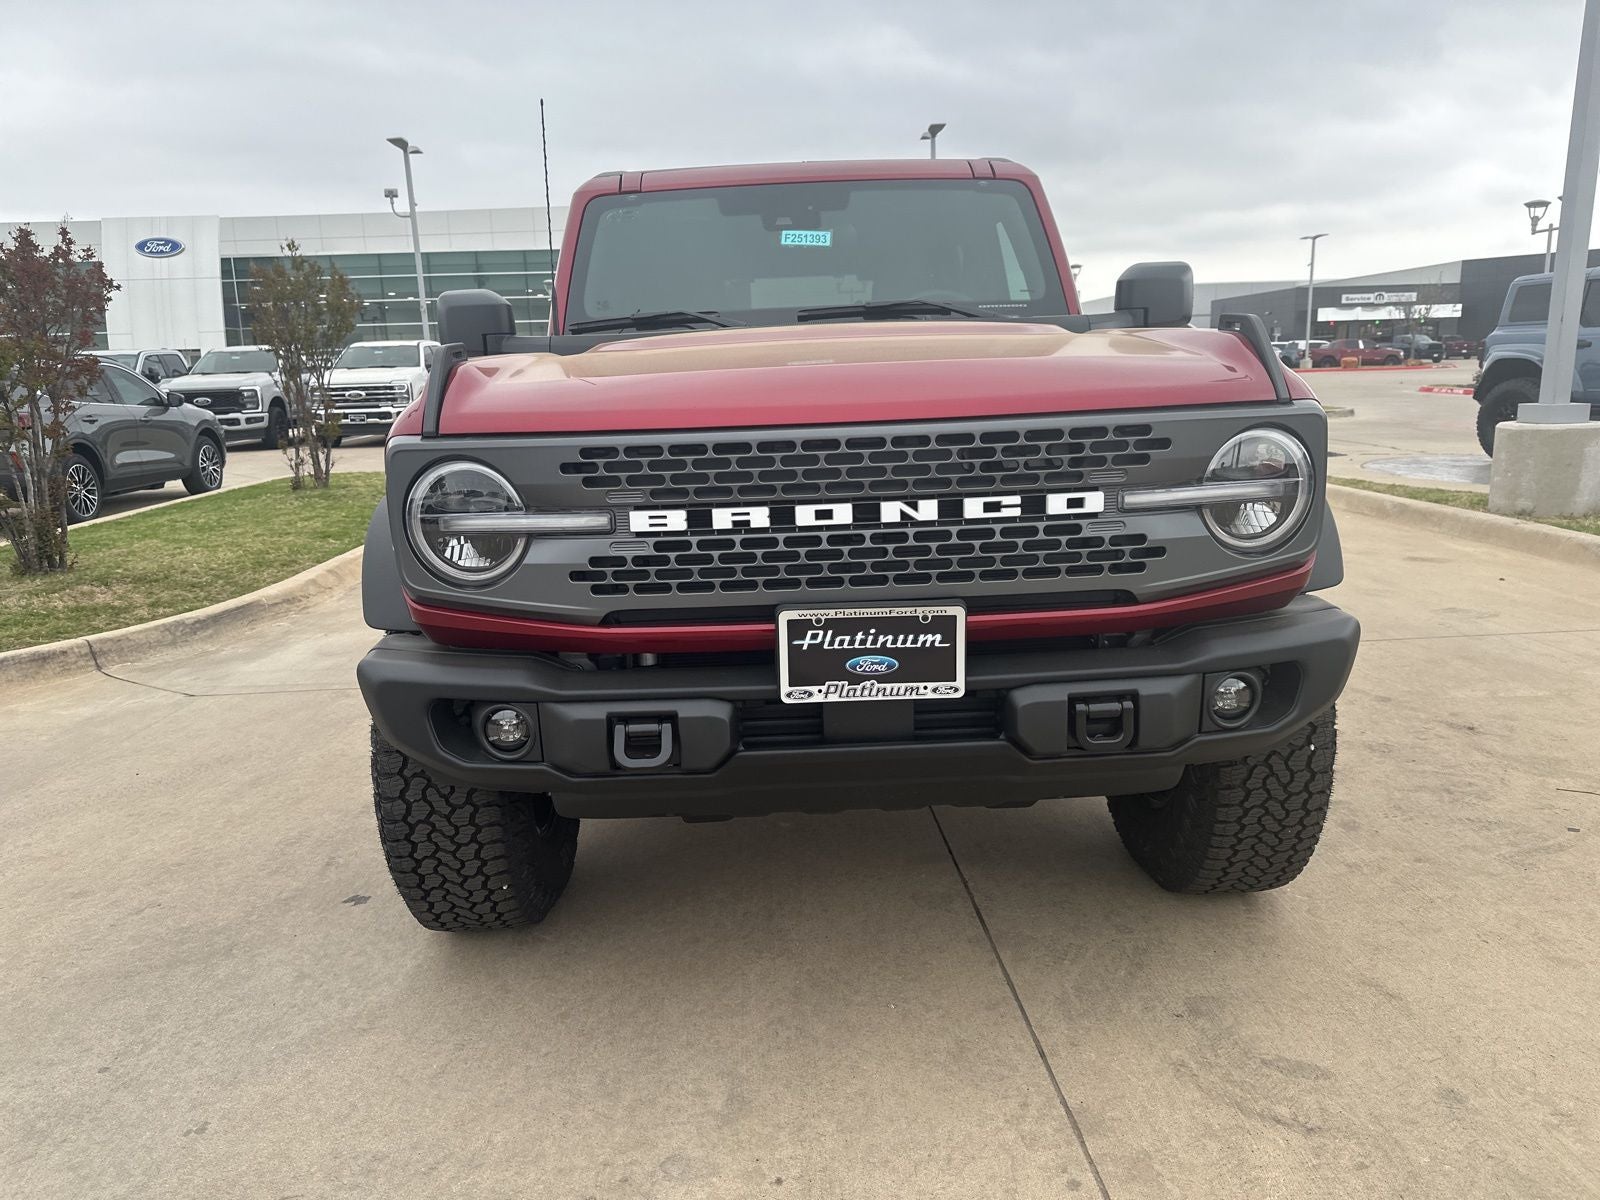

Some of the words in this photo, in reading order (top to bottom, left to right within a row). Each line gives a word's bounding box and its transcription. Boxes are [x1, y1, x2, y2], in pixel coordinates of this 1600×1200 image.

[784, 233, 827, 244] F251393
[144, 240, 172, 252] Ford
[629, 490, 1105, 533] BRONCO
[797, 608, 948, 618] www.PlatinumFord.com
[792, 628, 951, 650] Platinum
[856, 658, 888, 672] Ford
[824, 681, 929, 699] Platinum
